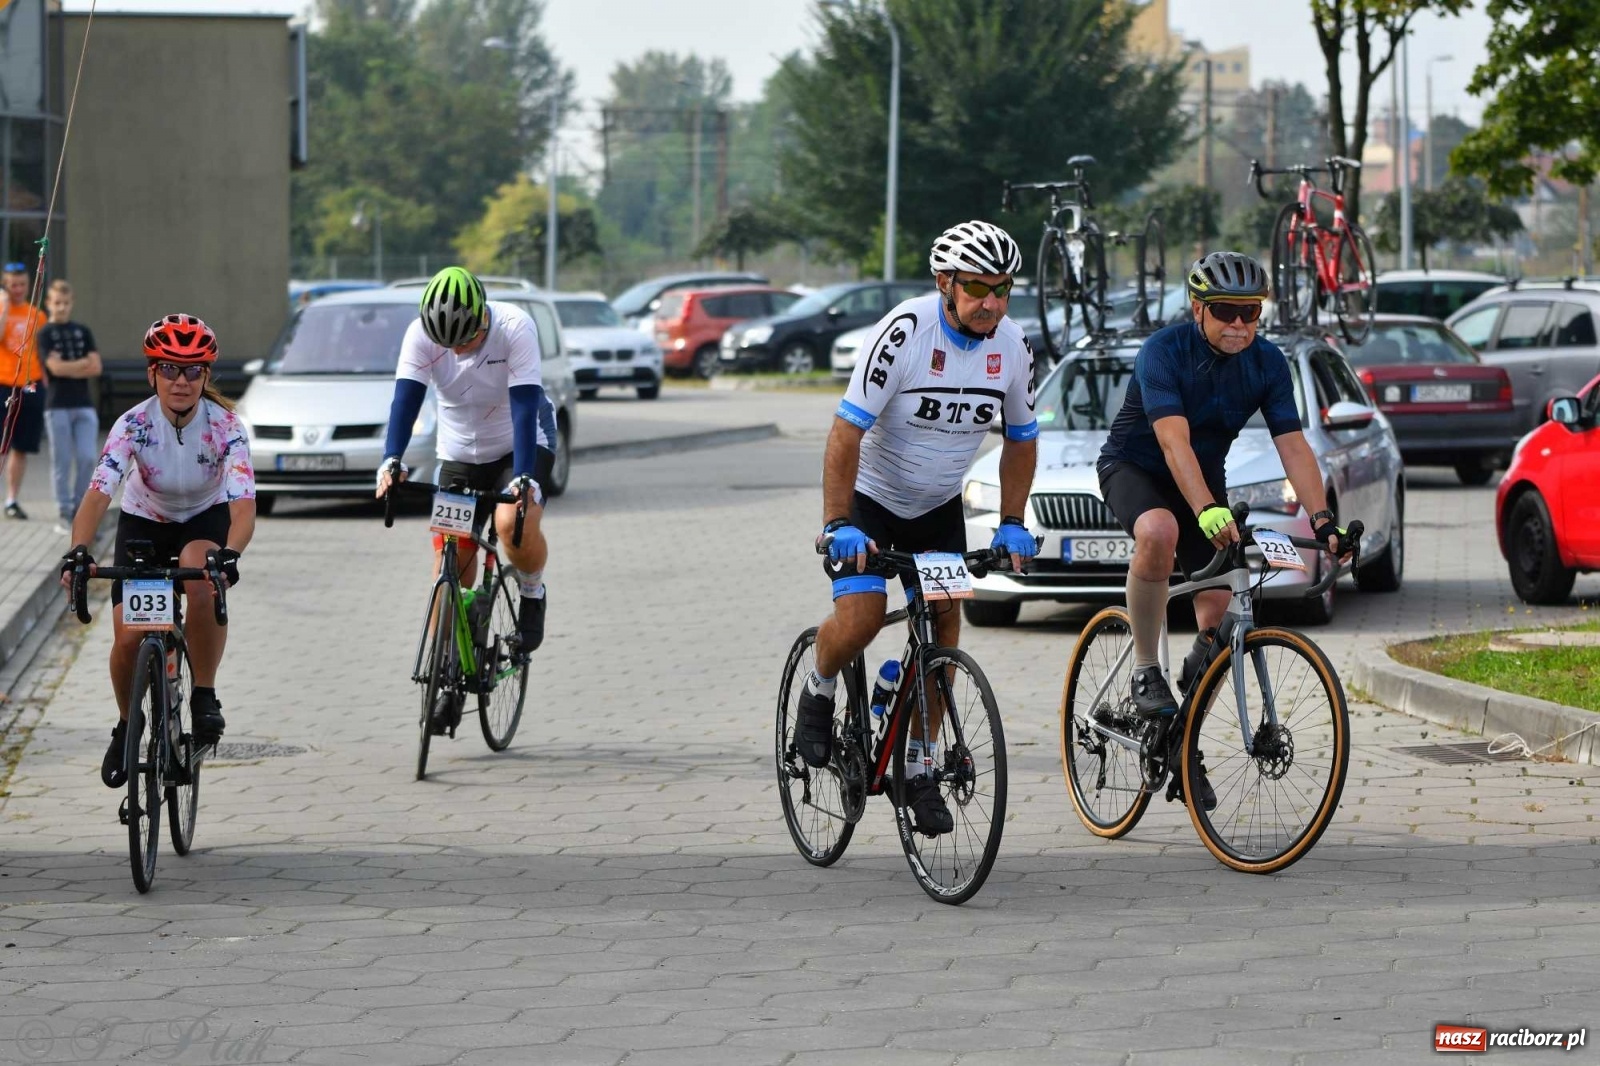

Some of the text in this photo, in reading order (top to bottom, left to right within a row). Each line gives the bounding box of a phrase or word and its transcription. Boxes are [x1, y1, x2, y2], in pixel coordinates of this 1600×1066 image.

[869, 327, 906, 390] BTS
[913, 396, 994, 424] BTS
[435, 505, 472, 522] 2119
[1075, 541, 1099, 559] SG
[1260, 541, 1297, 556] 2213
[921, 565, 966, 581] 2214
[129, 594, 167, 612] 033
